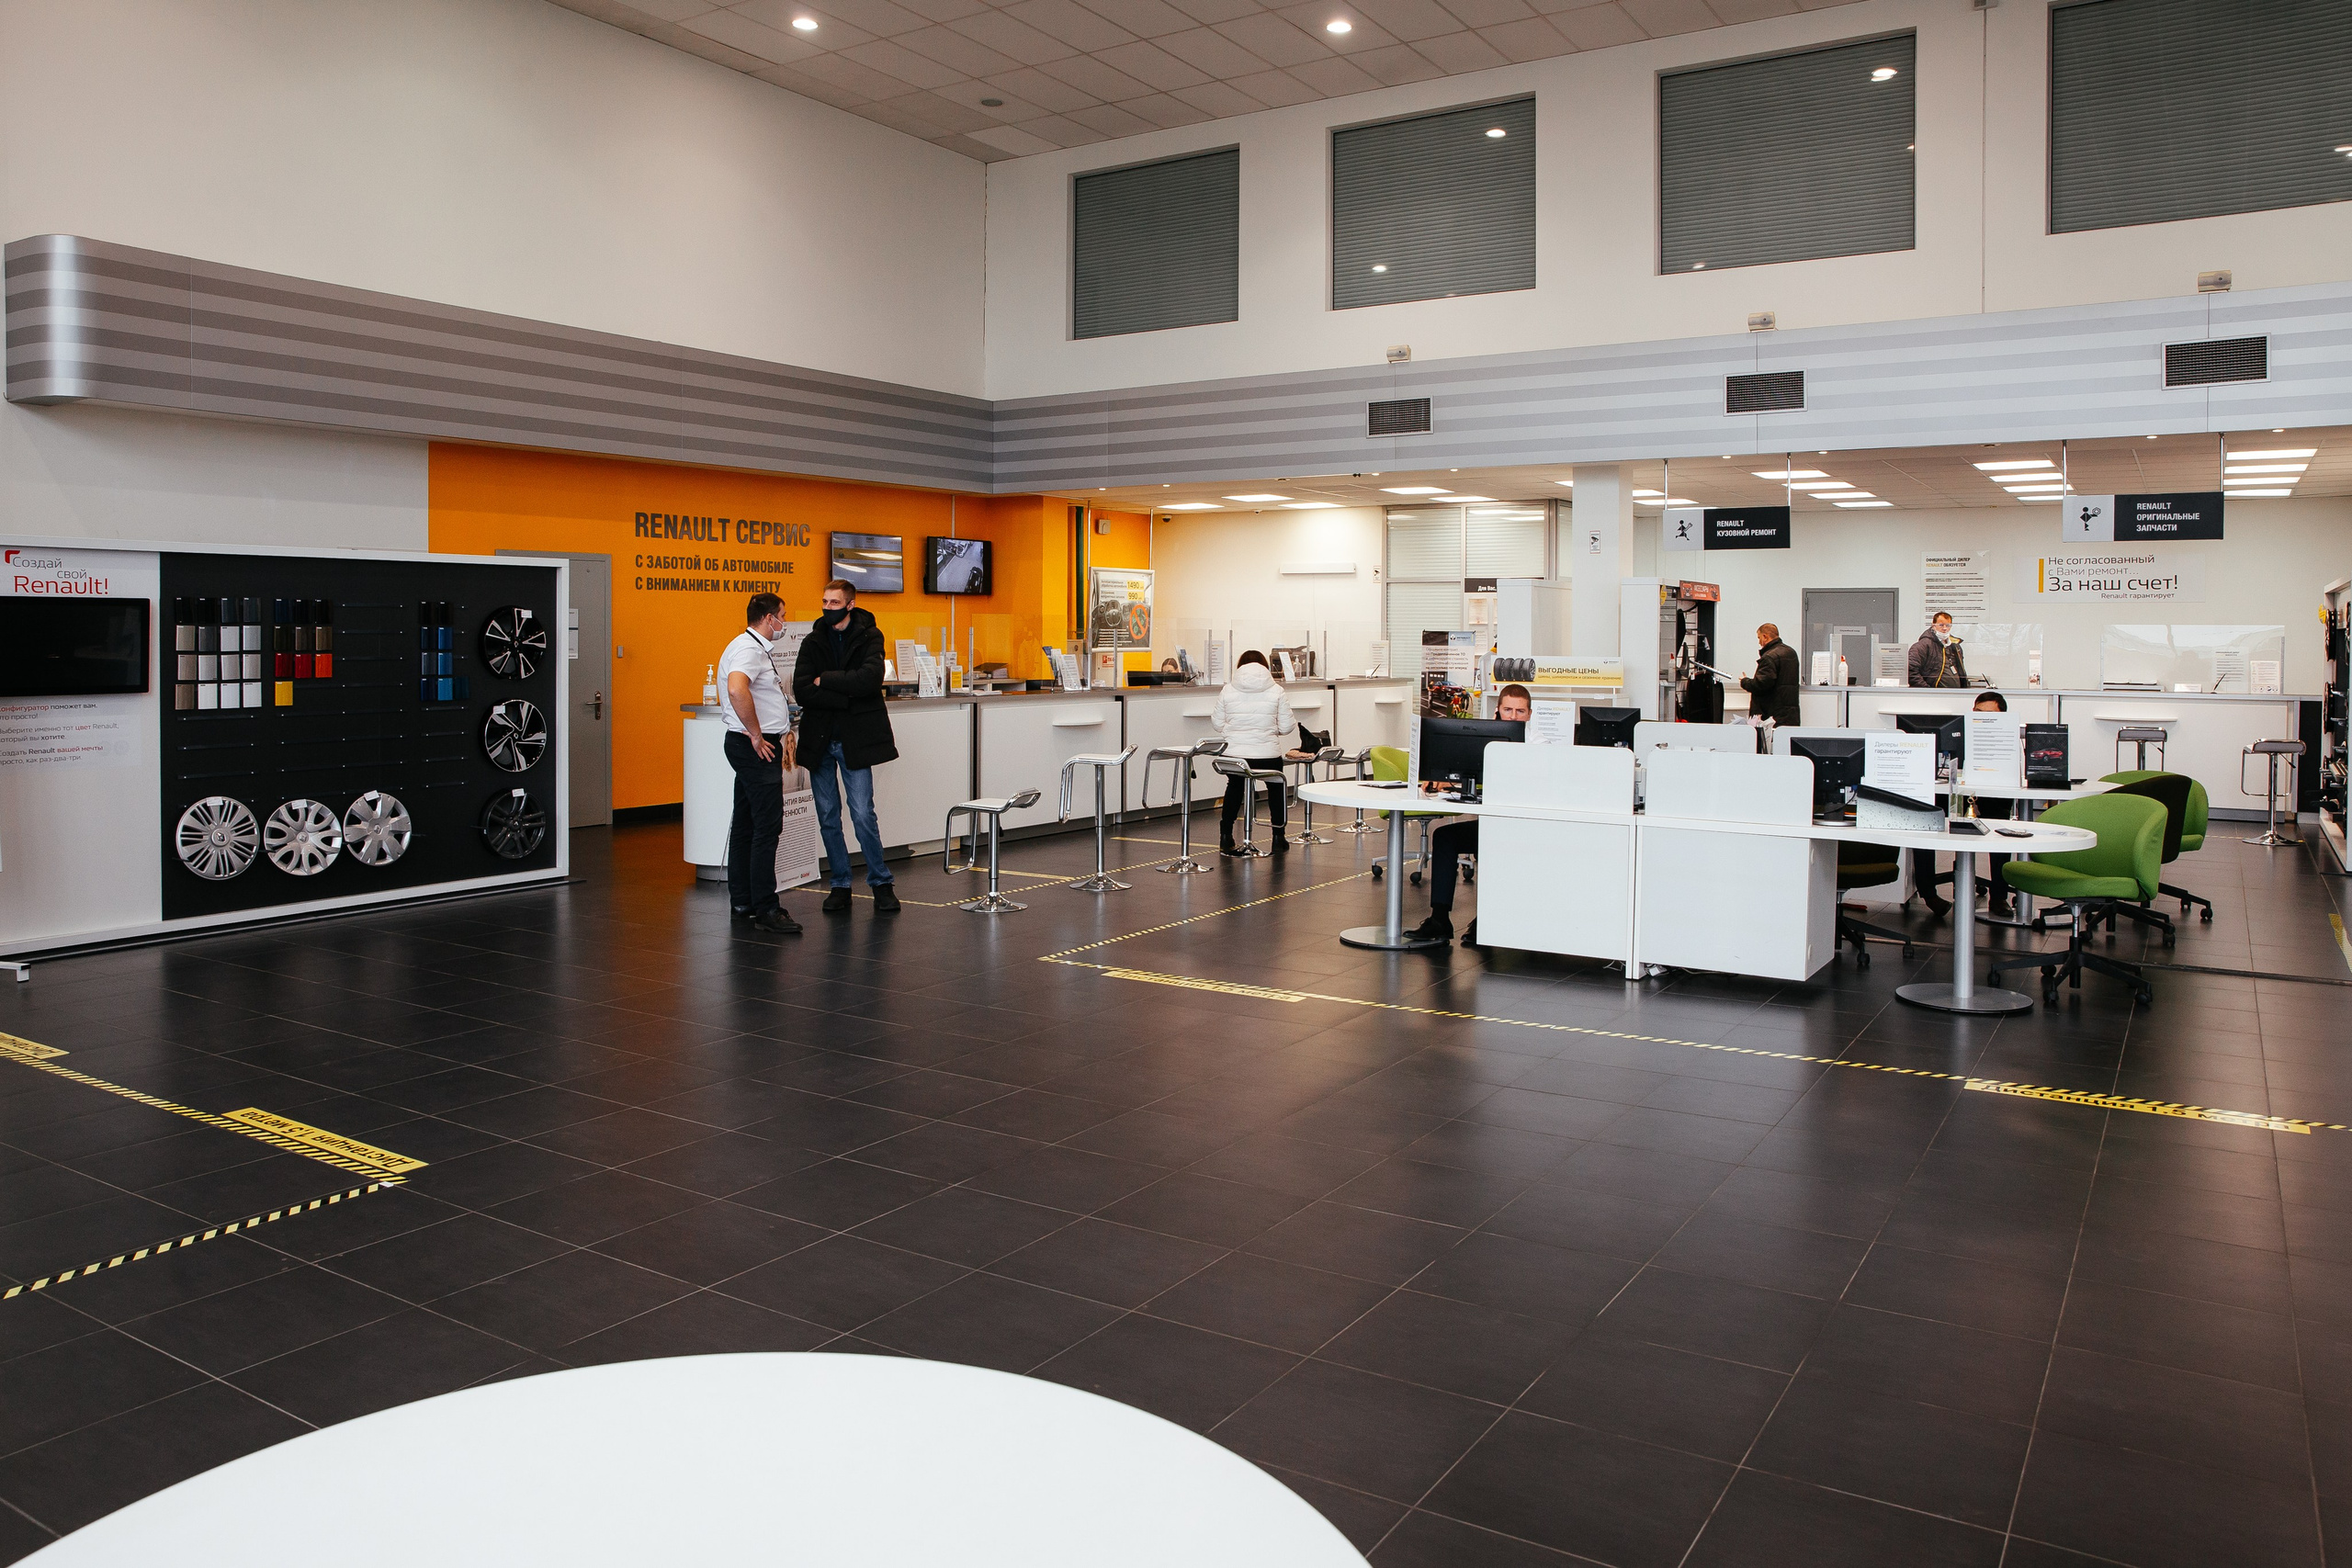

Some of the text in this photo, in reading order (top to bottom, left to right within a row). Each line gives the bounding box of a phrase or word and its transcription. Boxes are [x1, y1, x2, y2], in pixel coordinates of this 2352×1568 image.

[2136, 513, 2199, 521] ОРИГИНАЛЬНЫЕ
[635, 512, 810, 547] RENAULT СЕРВИС
[1717, 528, 1749, 536] КУЗОВНОЙ
[12, 556, 62, 570] Создай
[635, 554, 794, 574] С ЗАБОТОЙ ОБ АВТОМОБИЛЕ
[2048, 554, 2154, 565] Не согласованный
[57, 569, 87, 579] свой
[2056, 568, 2085, 576] Вами
[14, 575, 108, 594] Renault!
[635, 577, 781, 593] С ВНИМАНИЕМ К КЛИЕНТУ
[2049, 575, 2177, 592] За наш счет!
[11, 713, 38, 721] просто!
[0, 735, 28, 743] оторый
[1981, 1085, 2134, 1110] Дистанция
[2198, 1113, 2290, 1130] метра
[240, 1111, 414, 1168] Дистанция 1,5 метра
